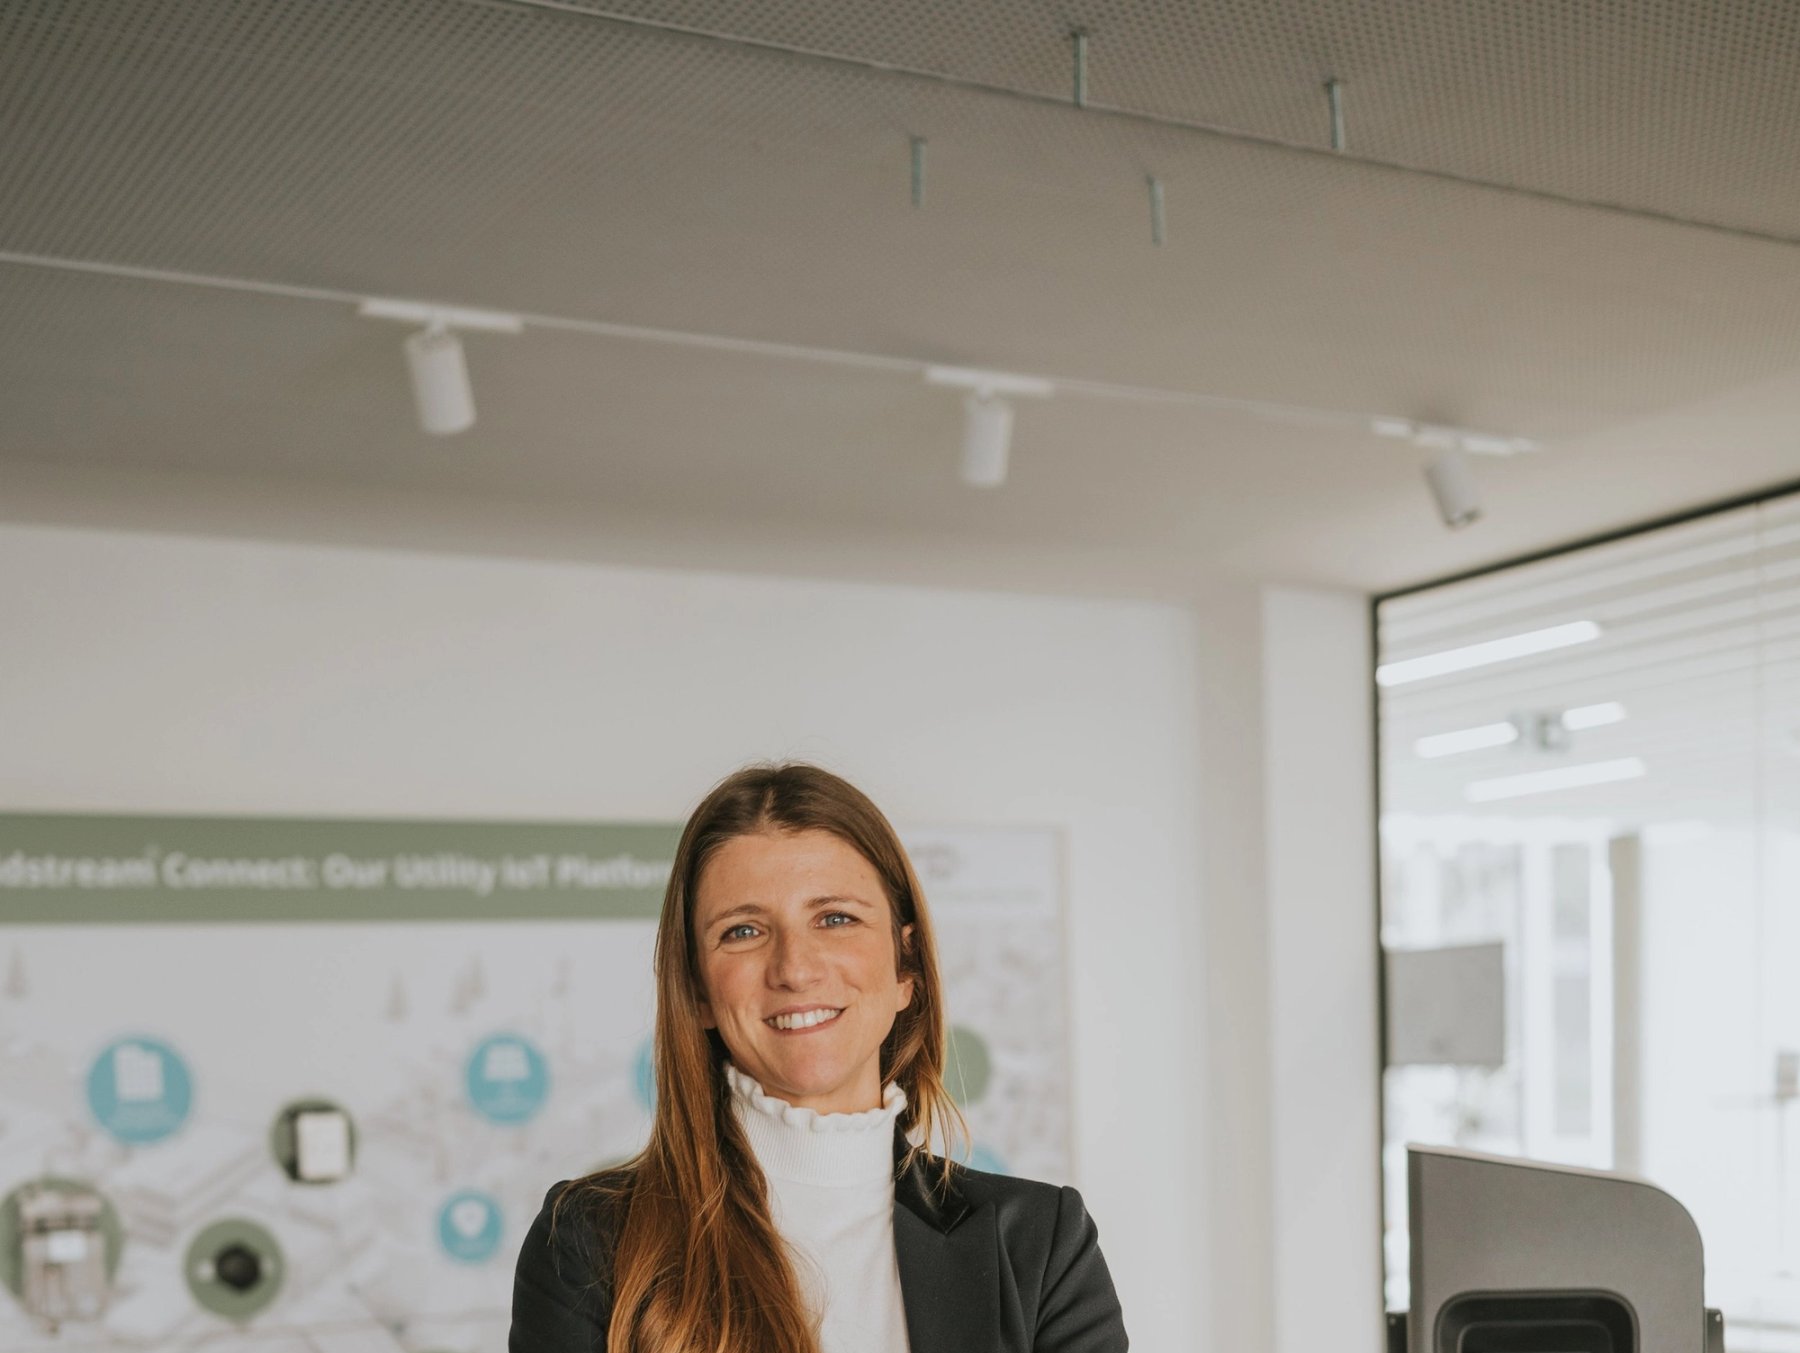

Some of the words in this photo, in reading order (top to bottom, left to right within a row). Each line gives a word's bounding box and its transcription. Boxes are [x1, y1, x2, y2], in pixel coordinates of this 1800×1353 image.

[322, 852, 387, 889] Our
[394, 851, 497, 897] Utility
[556, 853, 671, 889] Platfor
